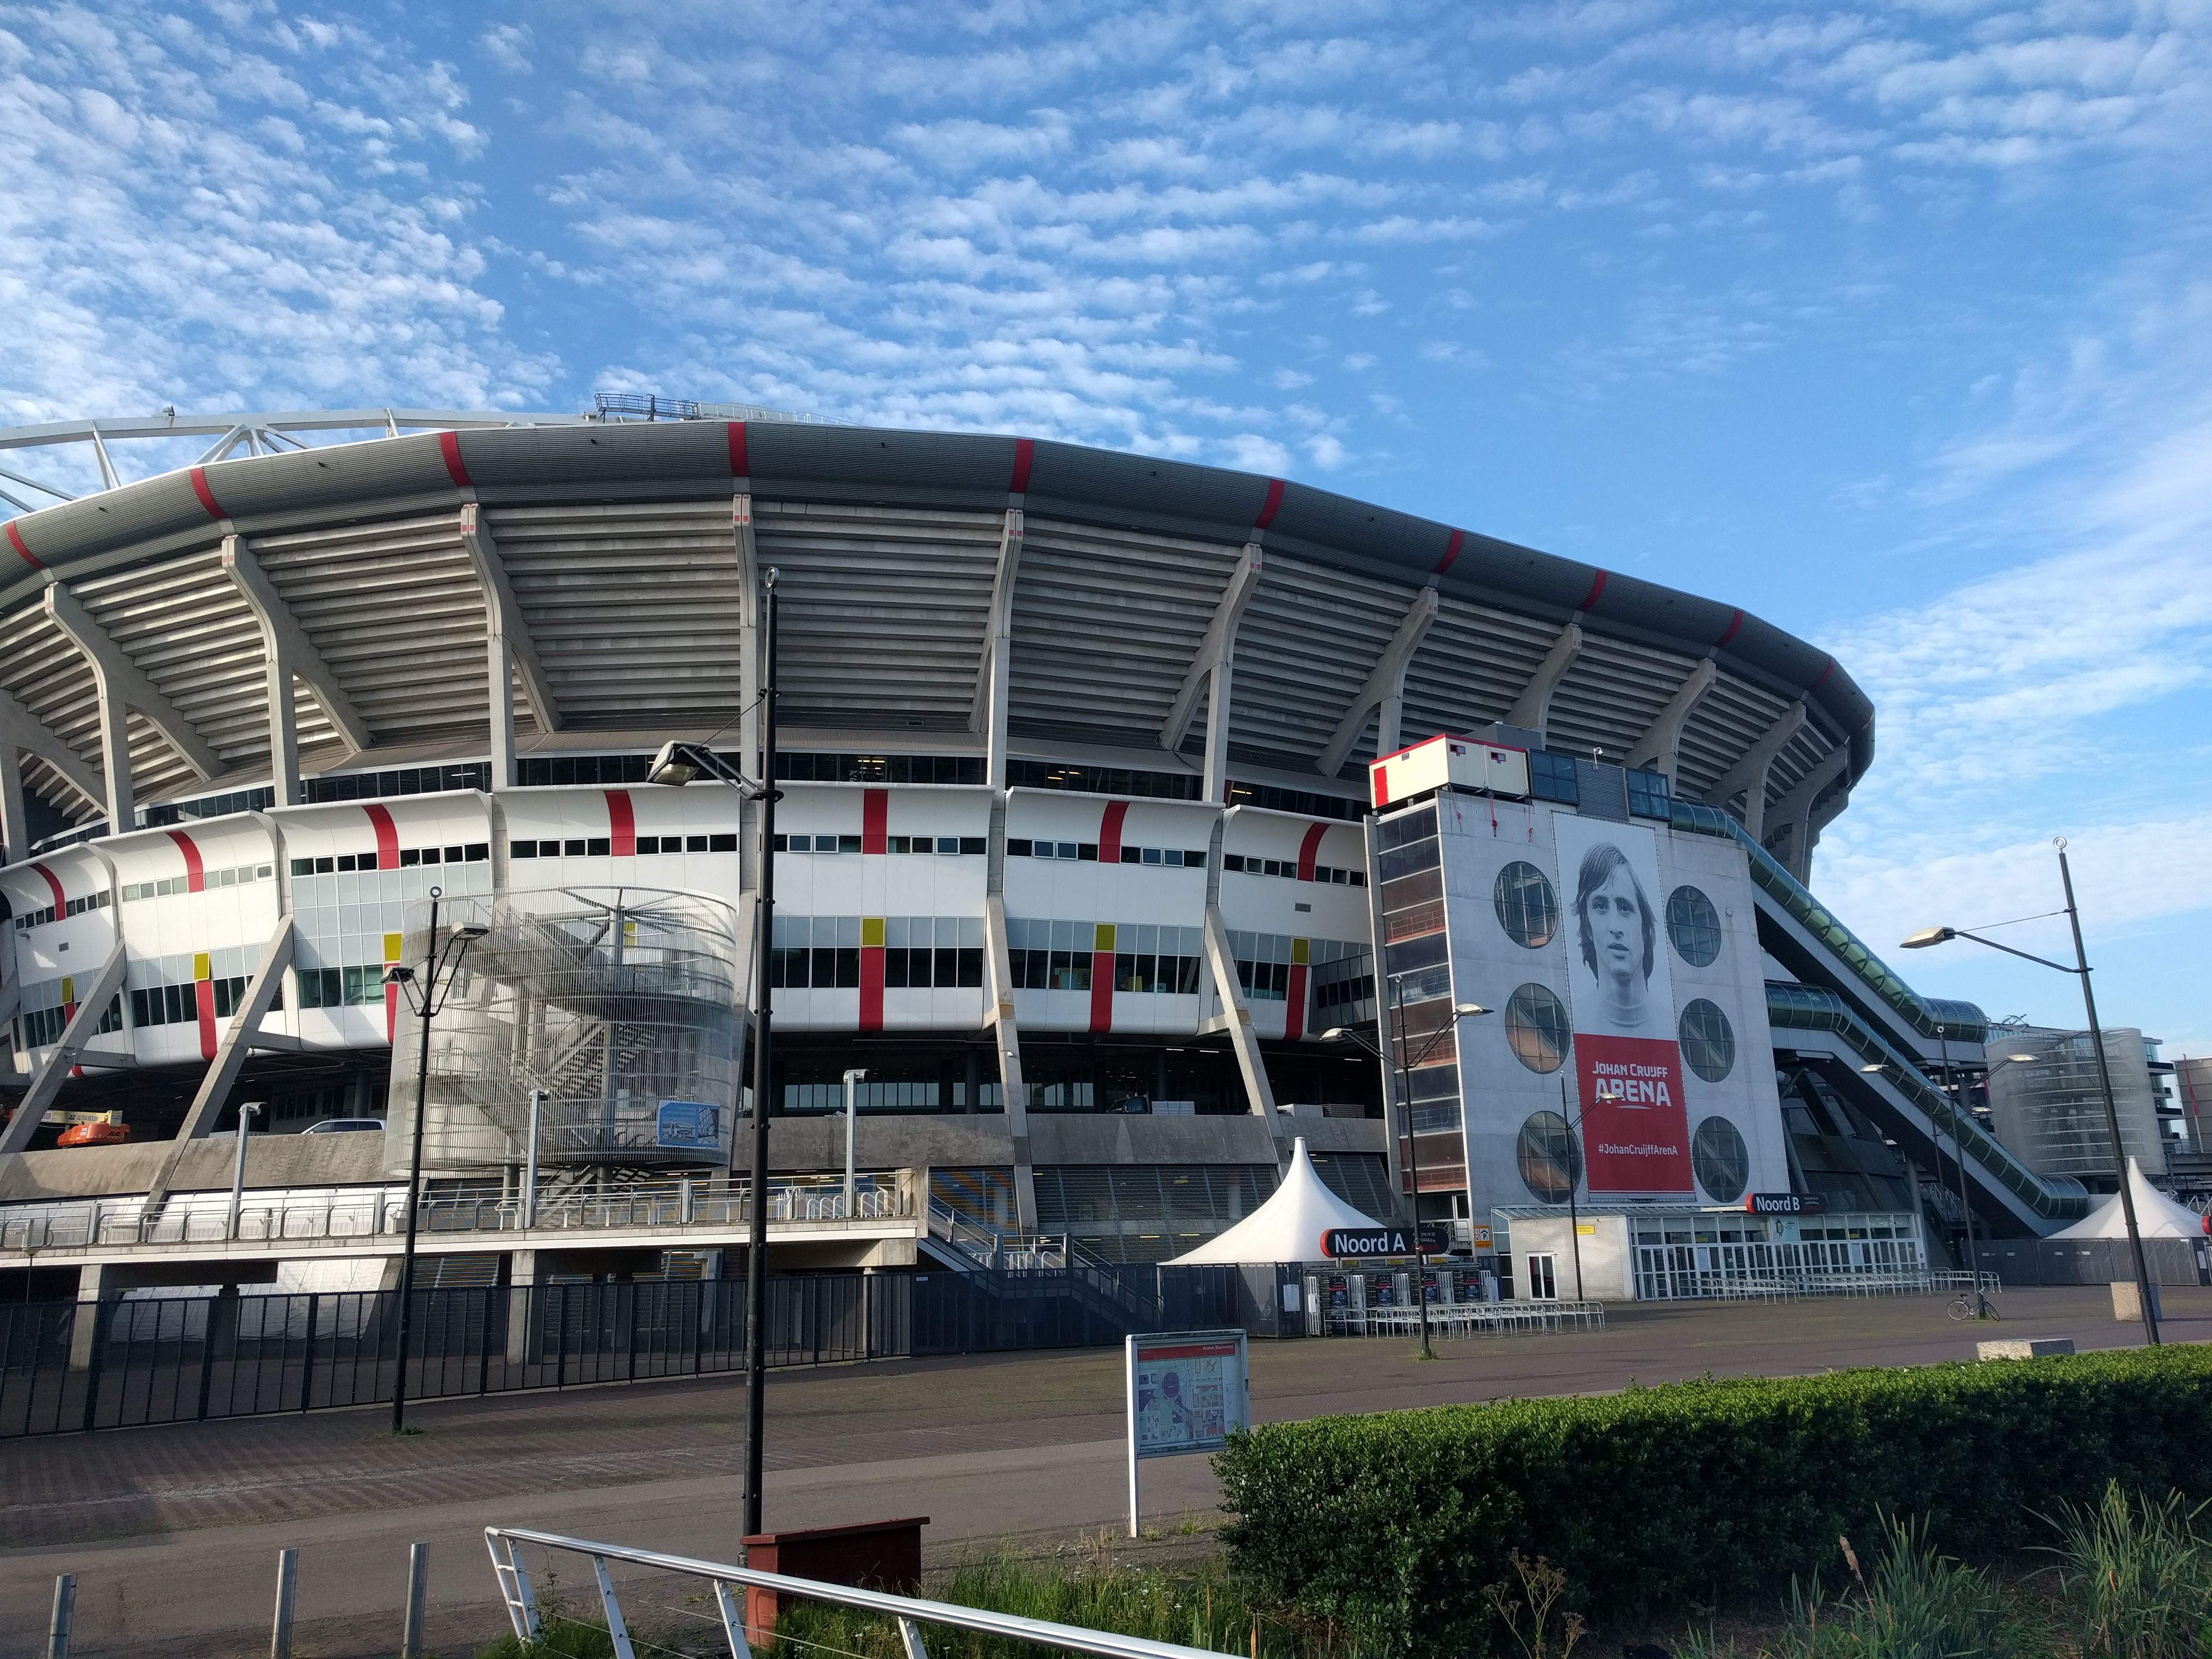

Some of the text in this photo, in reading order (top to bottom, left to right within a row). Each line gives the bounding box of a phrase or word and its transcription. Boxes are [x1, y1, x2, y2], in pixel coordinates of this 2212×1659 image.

[1592, 1061, 1628, 1076] JOHAN
[1595, 1078, 1672, 1107] ARENA
[1598, 1143, 1678, 1157] #JohanCruijffArenA
[1756, 1195, 1800, 1211] Noord B
[1335, 1232, 1407, 1253] Noord A
